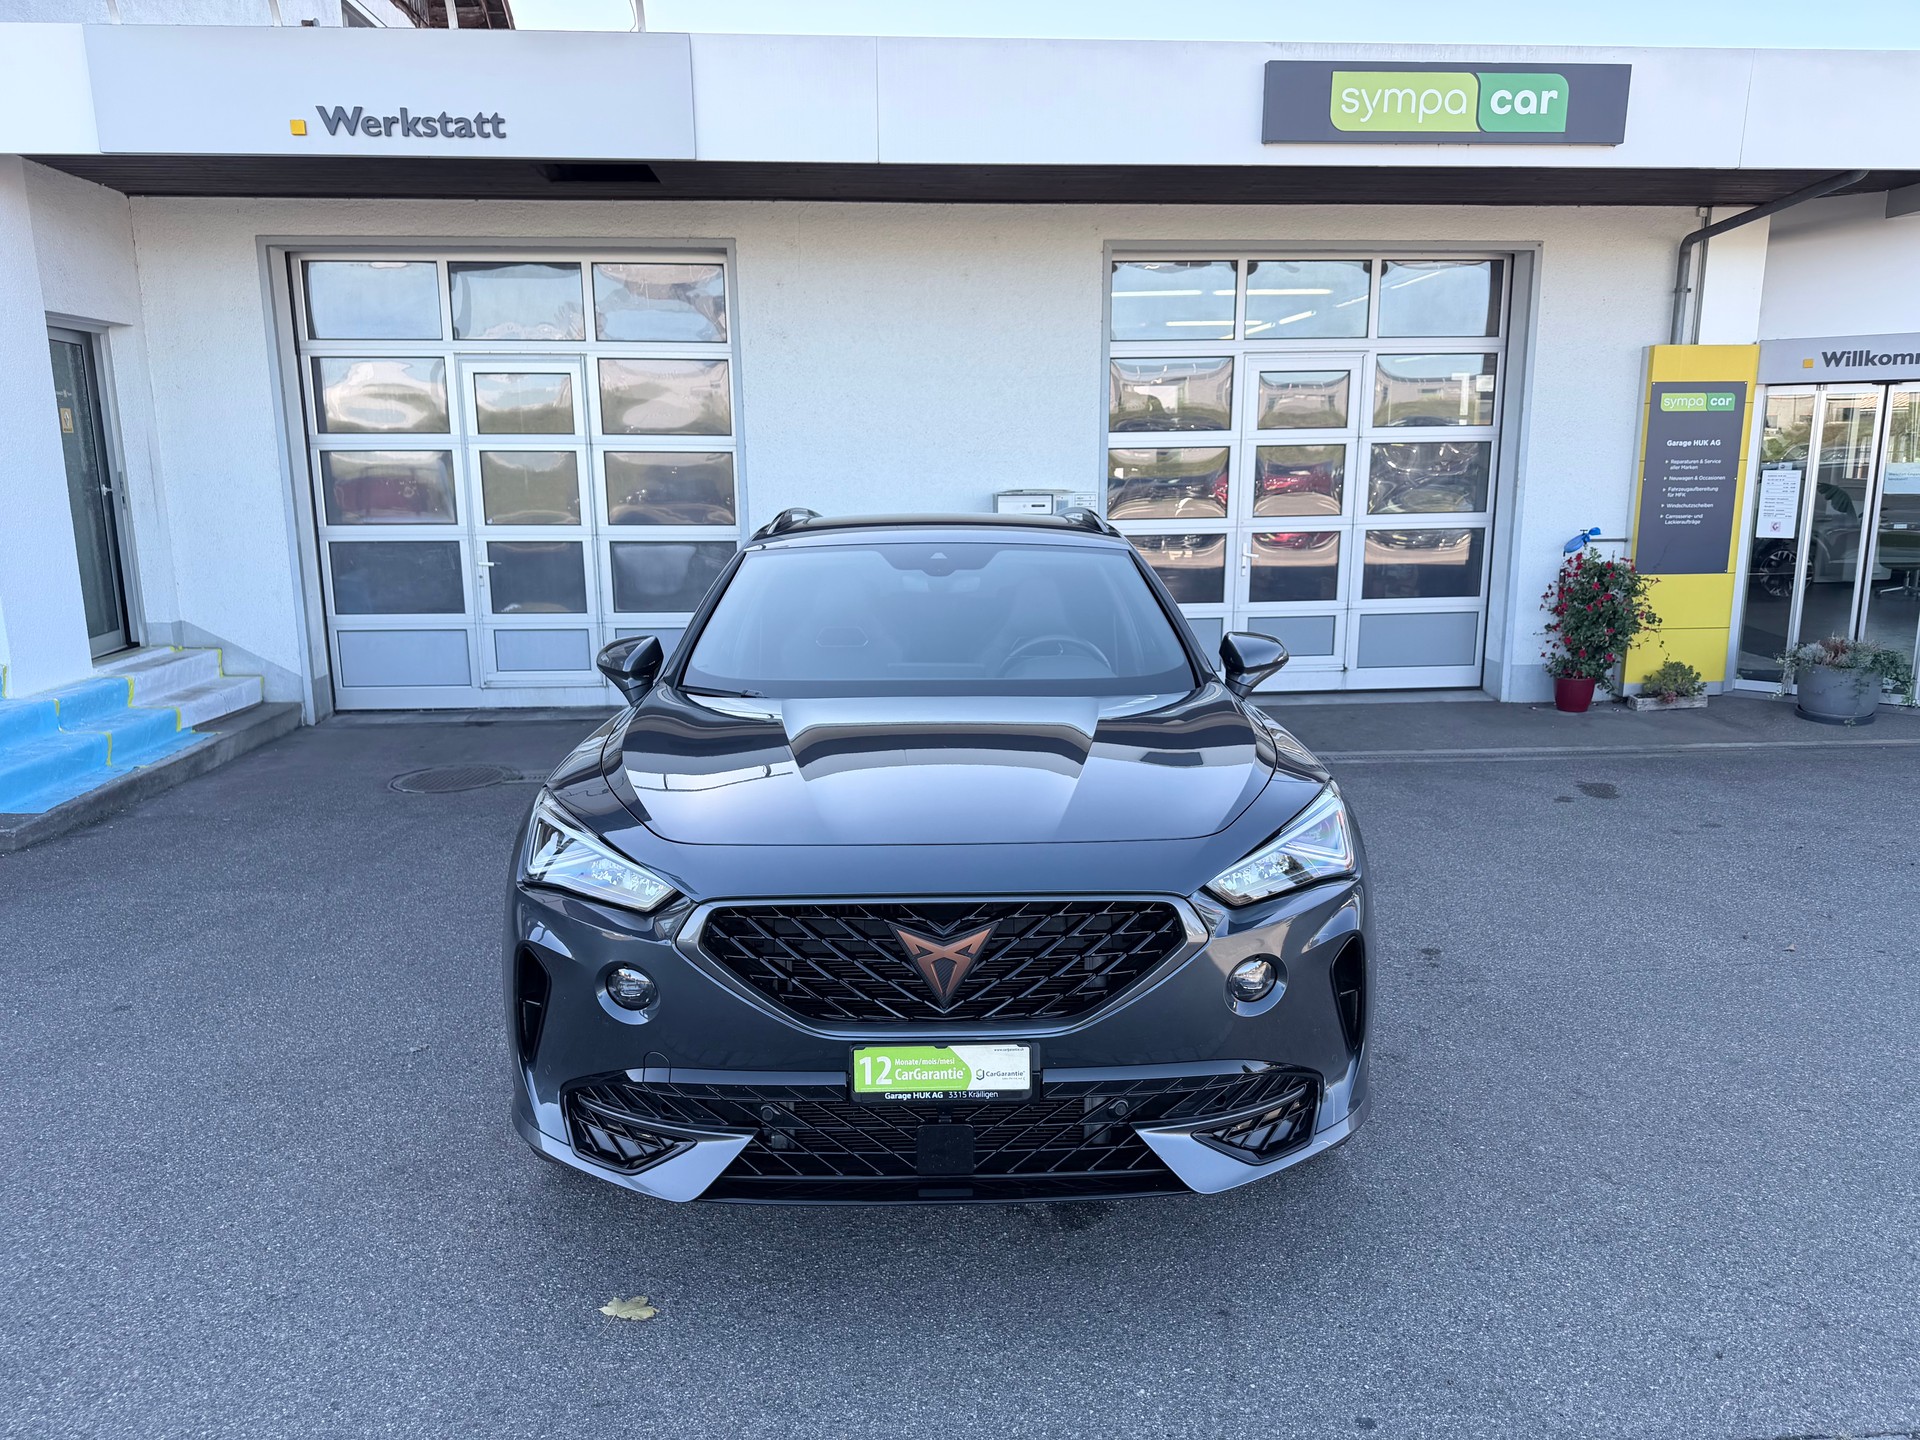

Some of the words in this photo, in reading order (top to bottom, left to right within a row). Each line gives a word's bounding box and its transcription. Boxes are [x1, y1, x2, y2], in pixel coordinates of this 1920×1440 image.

[1341, 87, 1467, 124] sympa
[1490, 89, 1558, 115] car
[315, 105, 507, 139] Werkstatt
[1821, 350, 1920, 367] Willkom
[1663, 397, 1704, 409] sympa
[1710, 397, 1732, 406] car
[894, 1058, 955, 1066] Monate/mois/mesi
[859, 1056, 893, 1086] 12
[884, 1092, 912, 1100] Garage
[930, 1091, 944, 1099] AG
